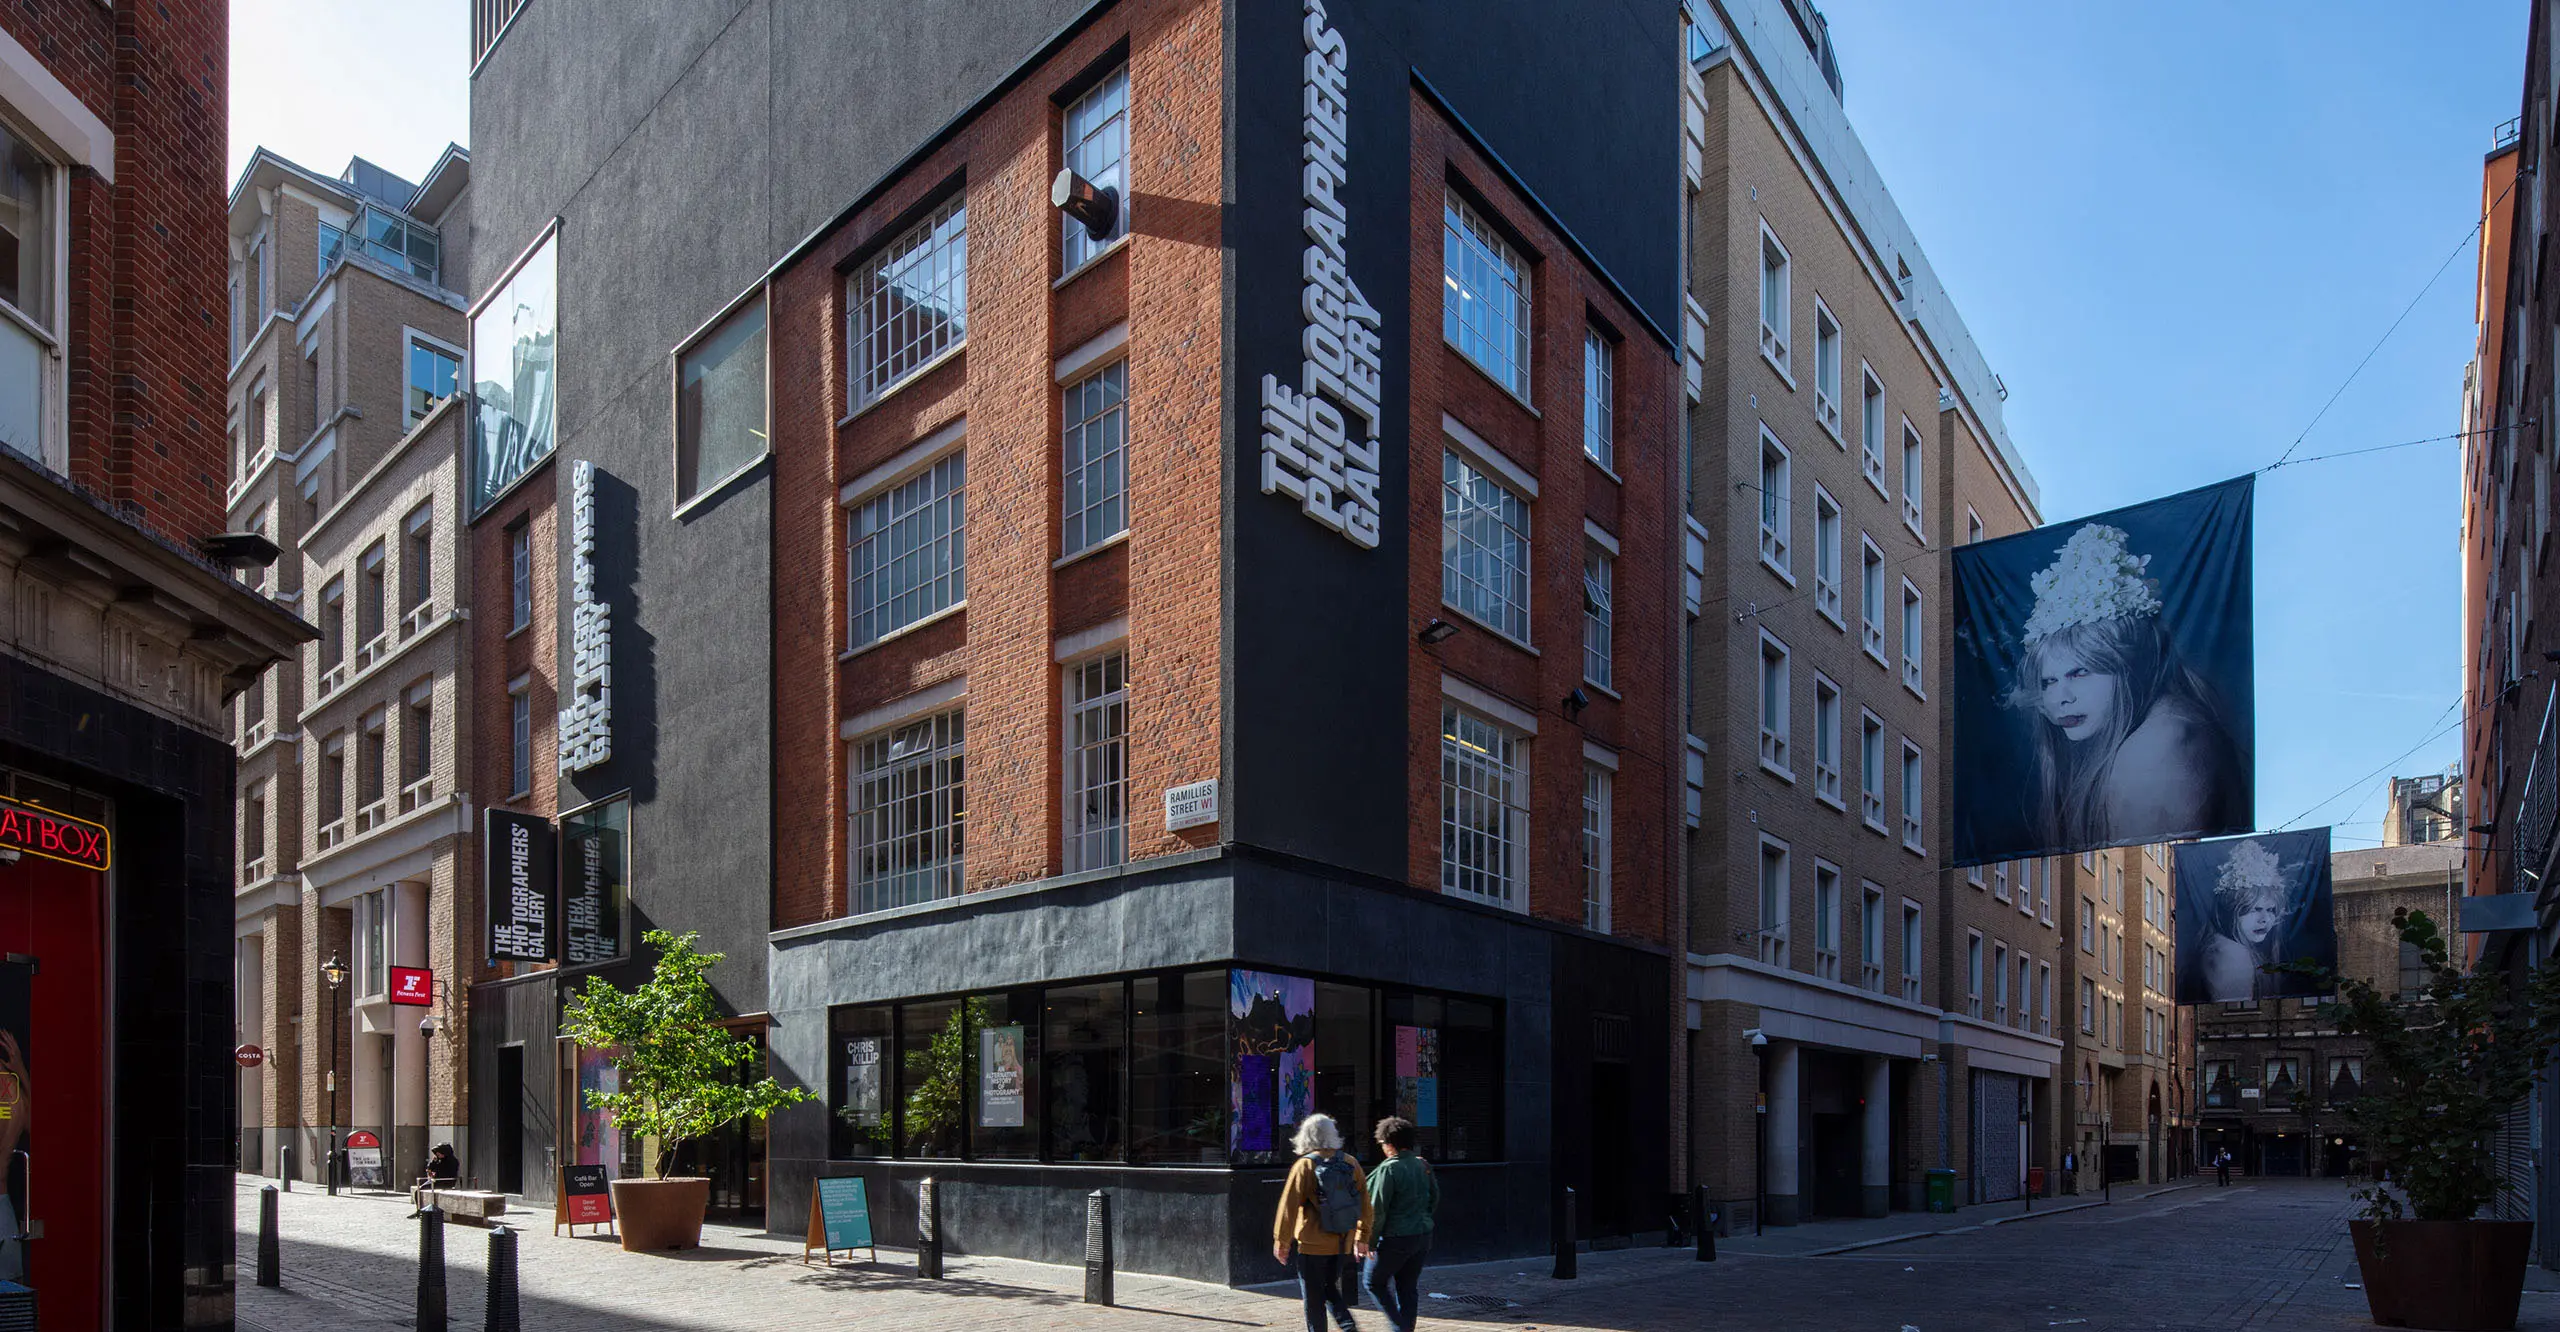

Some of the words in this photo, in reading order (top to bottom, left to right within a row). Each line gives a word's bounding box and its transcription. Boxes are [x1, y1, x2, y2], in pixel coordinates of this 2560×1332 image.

[1340, 276, 1381, 550] GALLERY
[1261, 373, 1307, 501] THE
[588, 600, 611, 764] GALLERY
[558, 703, 576, 778] THE
[1170, 784, 1212, 803] RAMILLIES
[1170, 801, 1198, 816] STREET
[1201, 797, 1212, 809] W1
[495, 924, 512, 954] THE
[528, 890, 546, 958] GALLERY
[848, 1041, 874, 1054] CHRIS
[853, 1052, 880, 1065] KILLIP
[984, 1088, 1020, 1096] PHOTOGRAPHY
